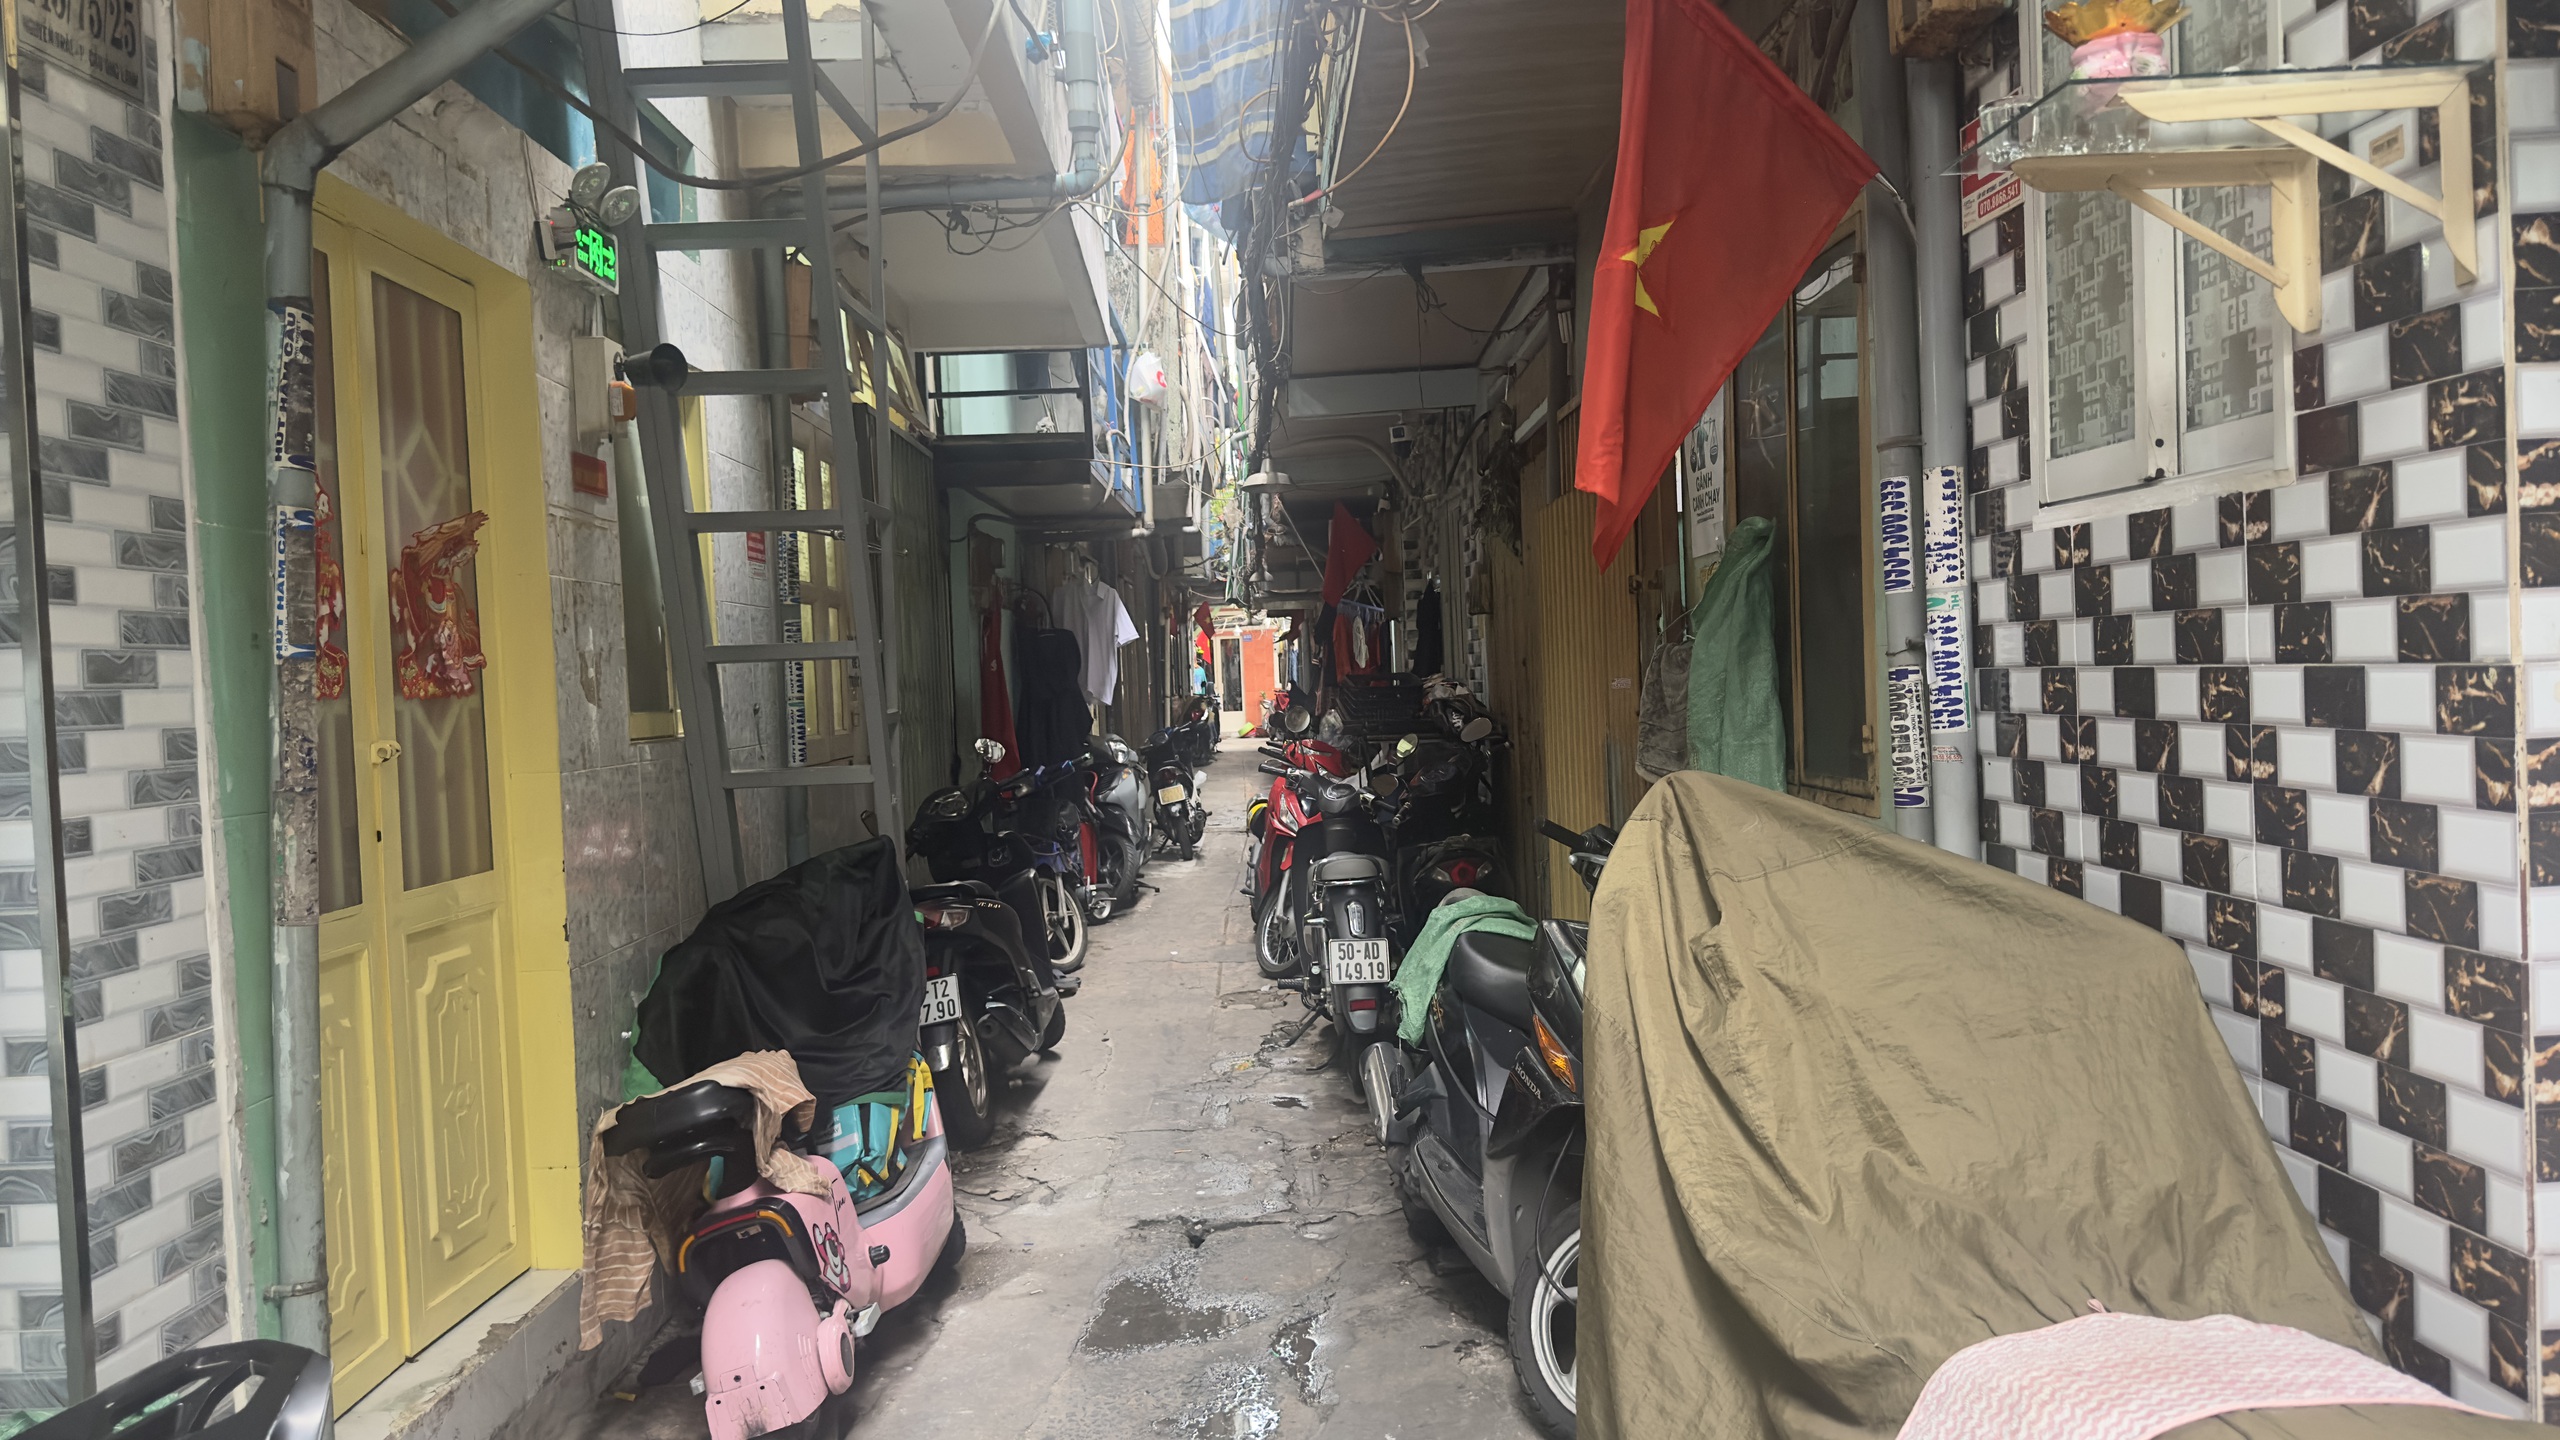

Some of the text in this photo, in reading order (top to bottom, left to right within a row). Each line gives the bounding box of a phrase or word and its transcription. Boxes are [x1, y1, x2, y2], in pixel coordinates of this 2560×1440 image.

[1338, 942, 1380, 960] 50-AD
[1336, 962, 1385, 980] 149.19
[921, 999, 956, 1023] 7.90
[1515, 1062, 1541, 1100] HONDA
